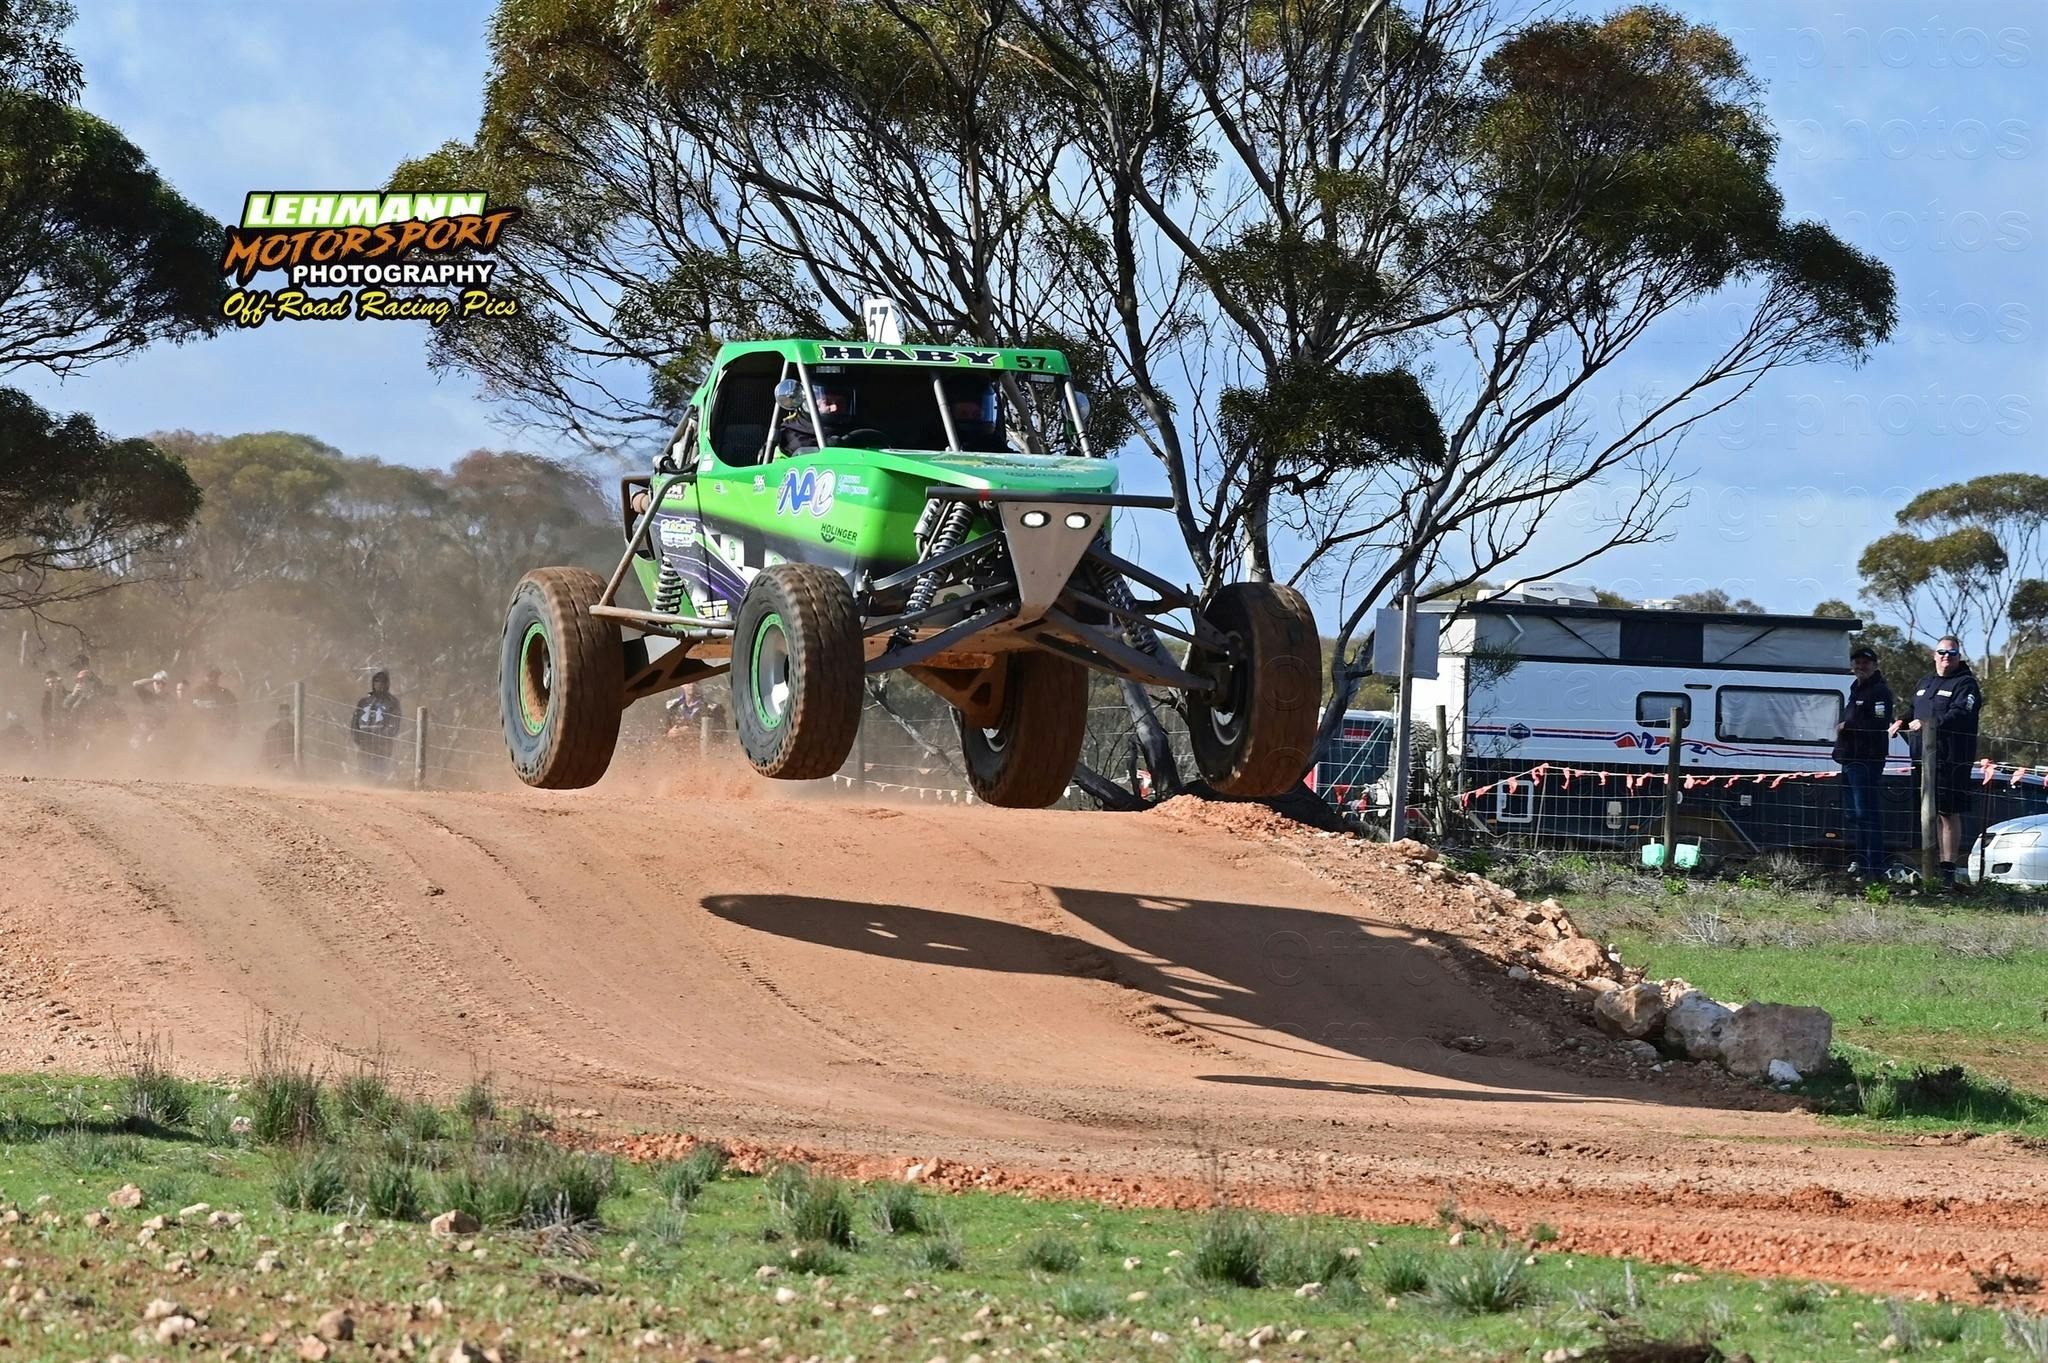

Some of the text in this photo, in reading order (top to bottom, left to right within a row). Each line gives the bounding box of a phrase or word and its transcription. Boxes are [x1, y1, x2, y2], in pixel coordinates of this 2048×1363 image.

[869, 306, 889, 344] 57
[820, 344, 1047, 371] HABY 57
[820, 522, 858, 542] HOLINGER
